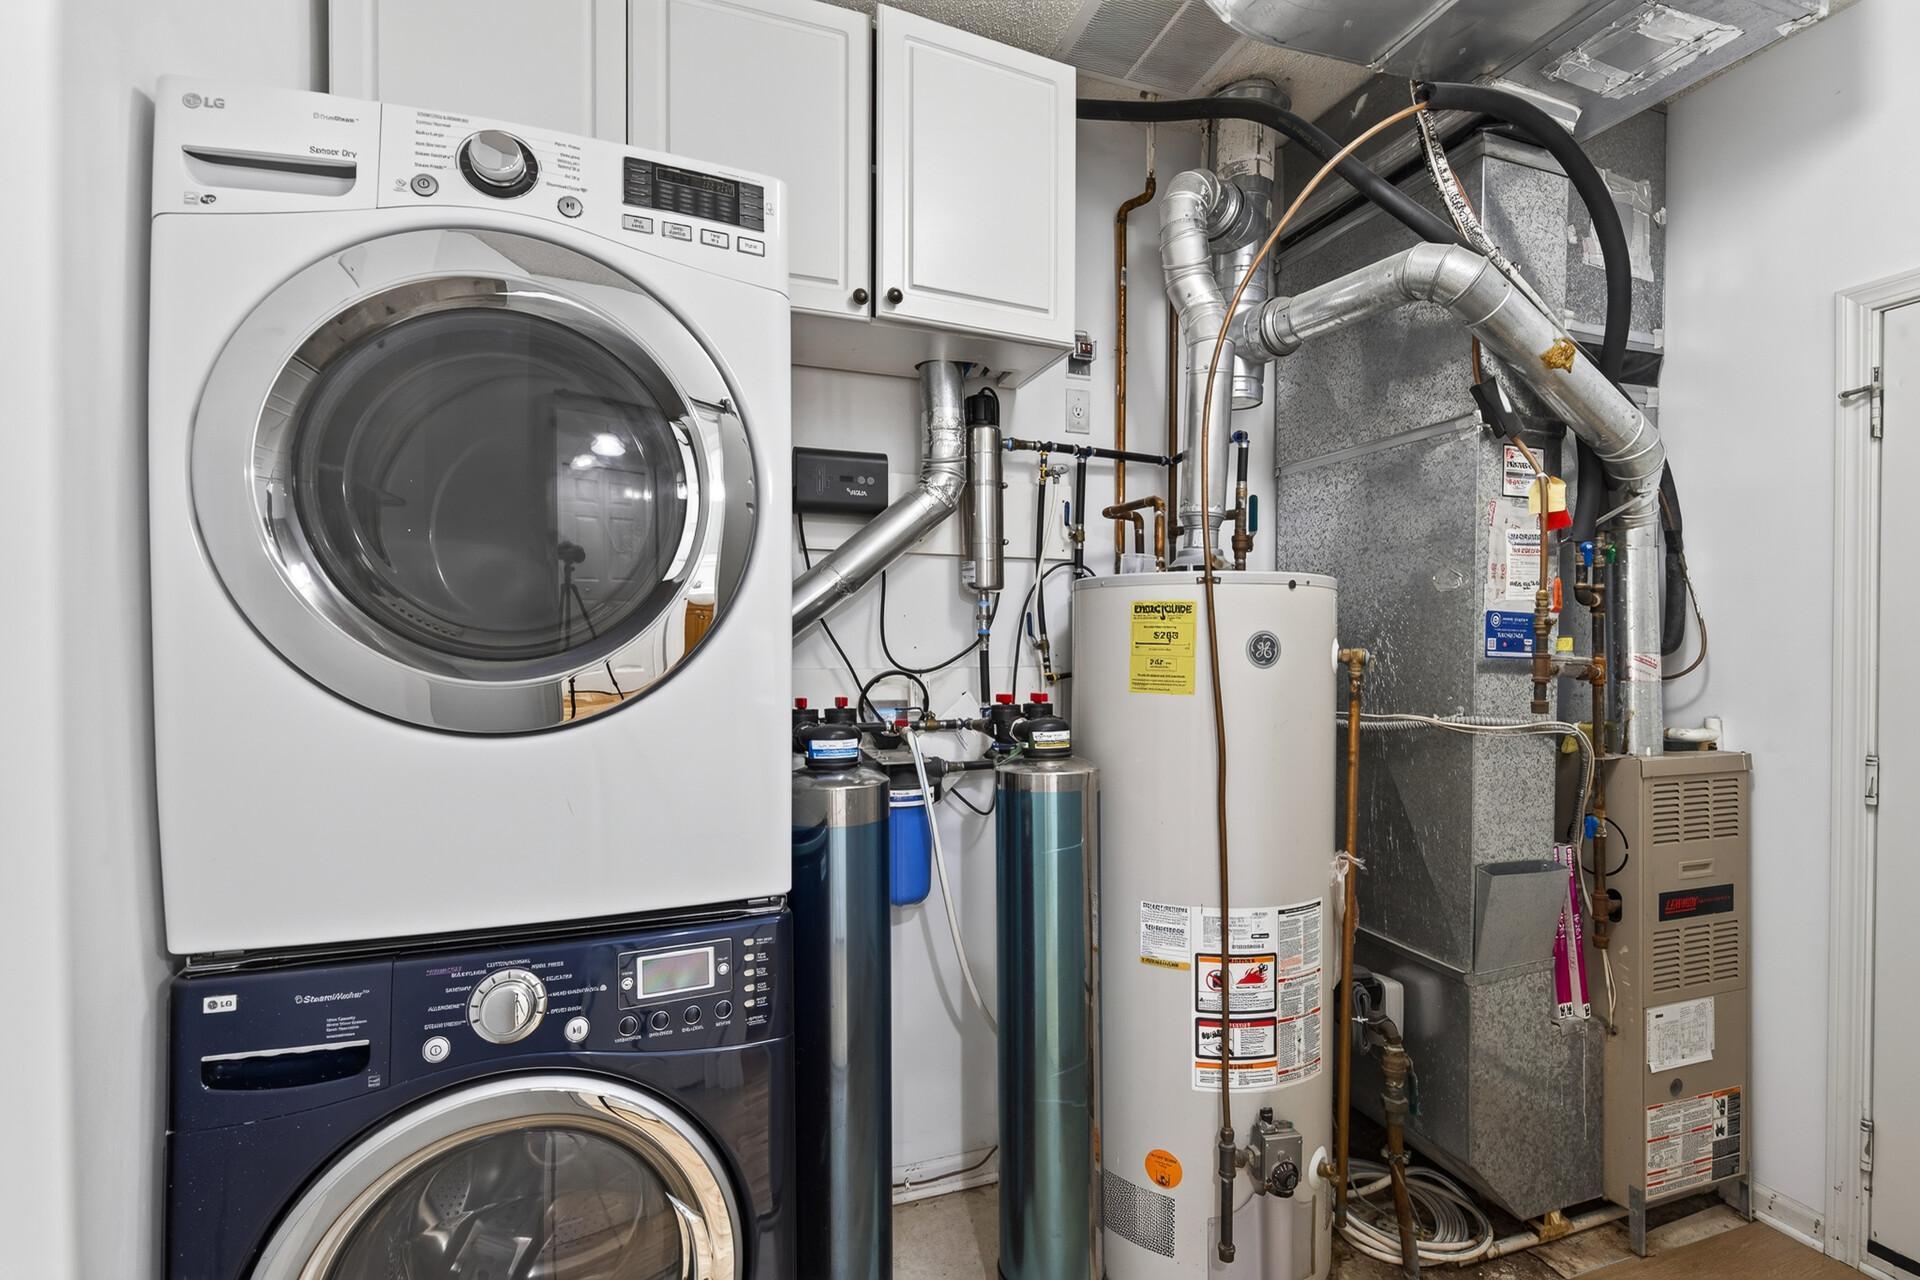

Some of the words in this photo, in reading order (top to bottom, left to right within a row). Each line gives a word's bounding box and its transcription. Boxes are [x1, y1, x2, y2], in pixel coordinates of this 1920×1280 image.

[204, 96, 225, 109] LG
[309, 145, 340, 156] Sensor
[342, 147, 358, 159] Dry
